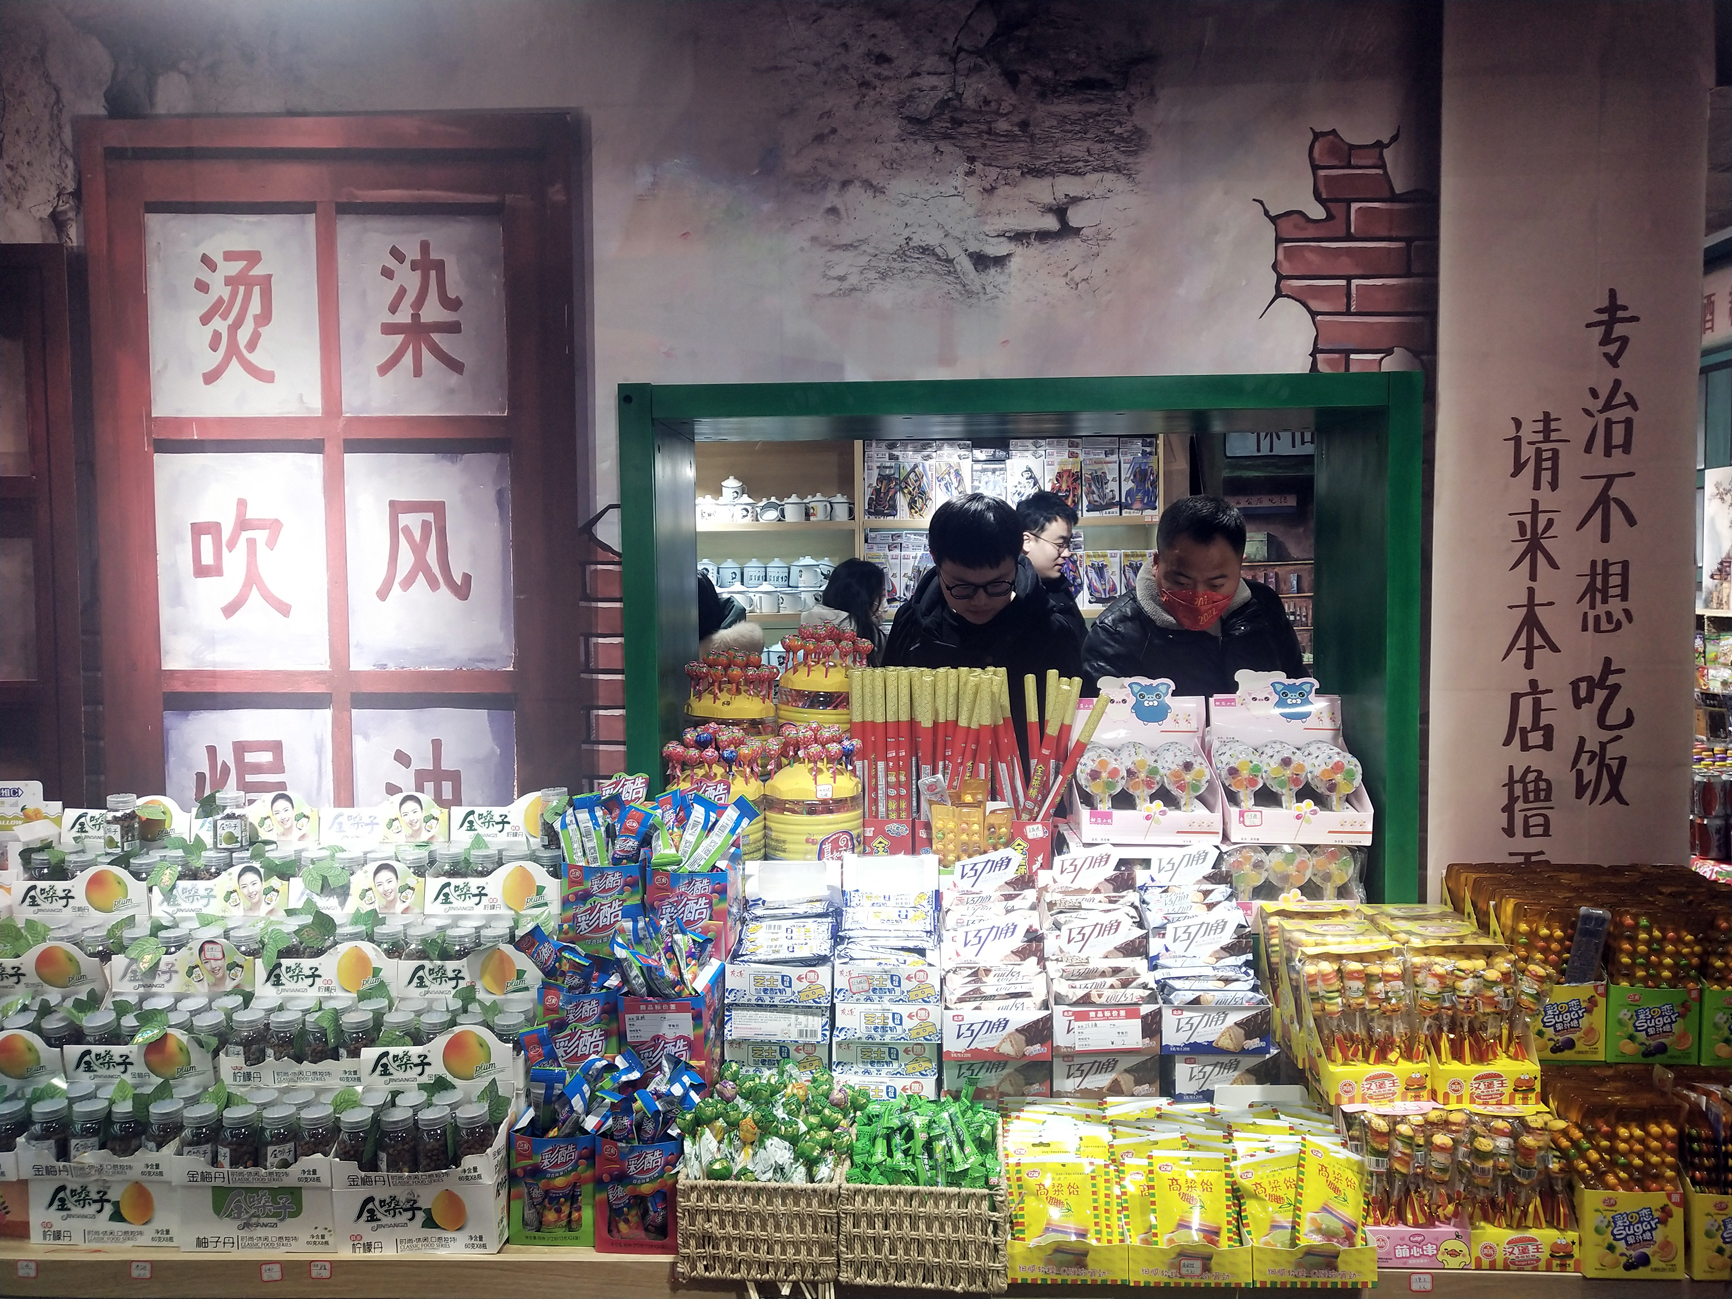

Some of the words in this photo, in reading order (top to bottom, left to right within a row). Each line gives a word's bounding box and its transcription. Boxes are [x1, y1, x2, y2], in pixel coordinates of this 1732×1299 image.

[1568, 287, 1641, 807] 专治不想吃饭
[1198, 607, 1219, 625] 2022
[1501, 410, 1571, 866] 请来本店撸
[457, 810, 511, 833] 金嗓子
[960, 856, 1012, 888] 巧力角
[1060, 853, 1112, 884] 巧力角
[1157, 850, 1209, 882] 巧力角
[433, 882, 488, 906] 金嗓子
[590, 871, 623, 896] 彩酷
[19, 885, 75, 908] 金嗓子
[113, 897, 133, 909] plum
[525, 895, 545, 906] plum
[577, 900, 624, 935] 彩酷
[659, 897, 709, 924] 彩酷
[963, 922, 1018, 957] 巧力角
[1067, 919, 1121, 954] 巧力角
[1172, 919, 1228, 953] 巧力角
[68, 974, 87, 985] plum
[263, 963, 322, 988] 金嗓子
[405, 964, 465, 990] 金嗓子
[505, 978, 526, 990] plum
[753, 976, 779, 988] 芝士
[566, 999, 599, 1023] 彩酷
[864, 1013, 890, 1025] 芝士
[1543, 1008, 1586, 1028] Sugar
[1174, 1011, 1229, 1043] 巧力角
[1635, 1012, 1679, 1032] Sugar
[955, 1018, 1010, 1049] 巧力角
[553, 1029, 606, 1062] 彩酷
[751, 1046, 777, 1058] 芝士
[860, 1047, 887, 1059] 芝士
[26, 1064, 47, 1075] plum
[75, 1049, 134, 1074] 金嗓子
[176, 1065, 197, 1077] plum
[370, 1051, 431, 1077] 金嗓子
[475, 1062, 497, 1076] plum
[232, 1072, 262, 1083] 柠檬丹
[1065, 1058, 1119, 1088] 巧力角
[1188, 1059, 1241, 1090] 巧力角
[1361, 1077, 1400, 1092] 汉堡王
[1469, 1079, 1508, 1091] 汉堡王
[540, 1145, 577, 1172] 彩酷
[627, 1151, 664, 1176] 彩酷
[187, 1170, 226, 1183] 金梅丹
[347, 1174, 386, 1187] 金梅丹
[1168, 1177, 1214, 1193] 高粱饴
[1252, 1176, 1298, 1196] 高粱饴
[1318, 1163, 1358, 1191] 高粱饴
[47, 1185, 111, 1213] 金嗓子
[1035, 1182, 1080, 1197] 高粱饴
[217, 1189, 296, 1223] 金嗓子
[353, 1195, 423, 1224] 金嗓子
[42, 1229, 72, 1242] 柠檬丹
[237, 1221, 278, 1230] JINSANGZI
[371, 1222, 408, 1232] JINSANGZI
[1613, 1219, 1659, 1239] Sugar
[195, 1235, 235, 1249] 柚子丹
[351, 1241, 384, 1254] 柠檬丹
[1395, 1243, 1437, 1257] 萌心串
[1502, 1243, 1545, 1256] 汉堡王
